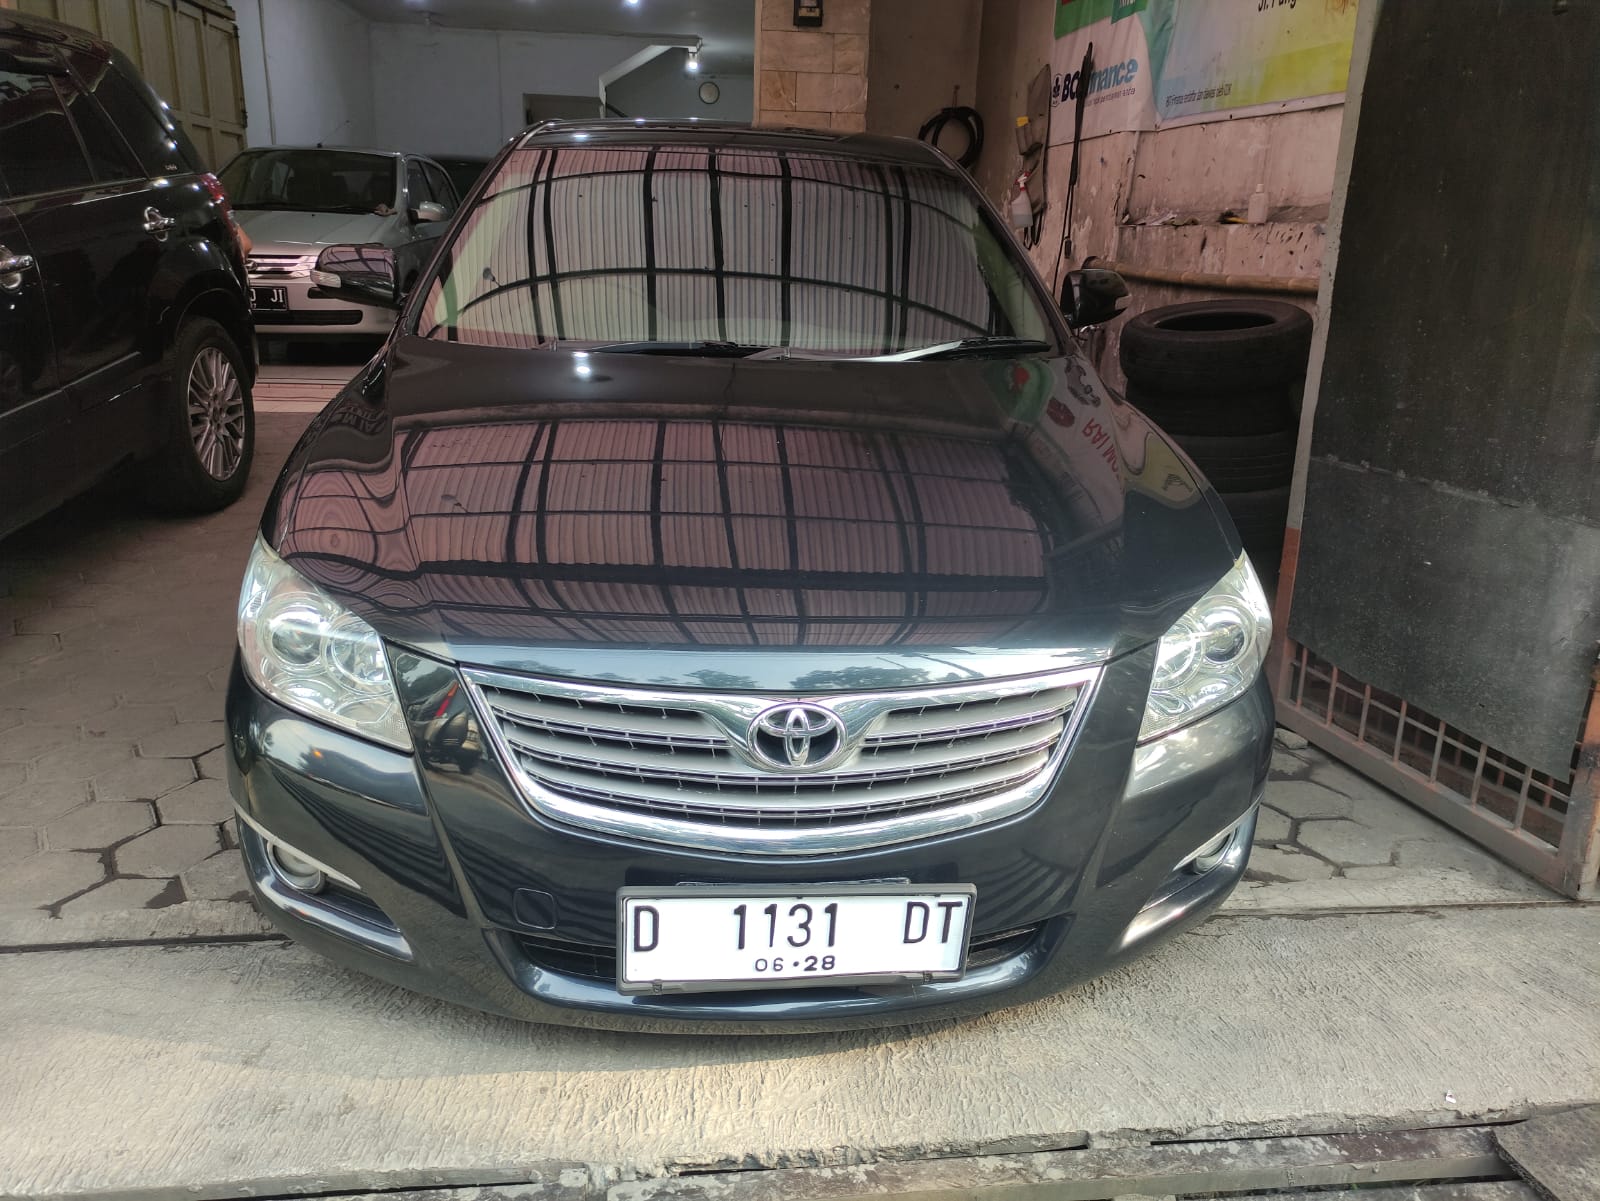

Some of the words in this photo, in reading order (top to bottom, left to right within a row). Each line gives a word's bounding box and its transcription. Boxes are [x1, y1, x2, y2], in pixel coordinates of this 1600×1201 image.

[633, 905, 660, 952] D
[733, 903, 838, 950] 1131
[902, 901, 963, 944] DT
